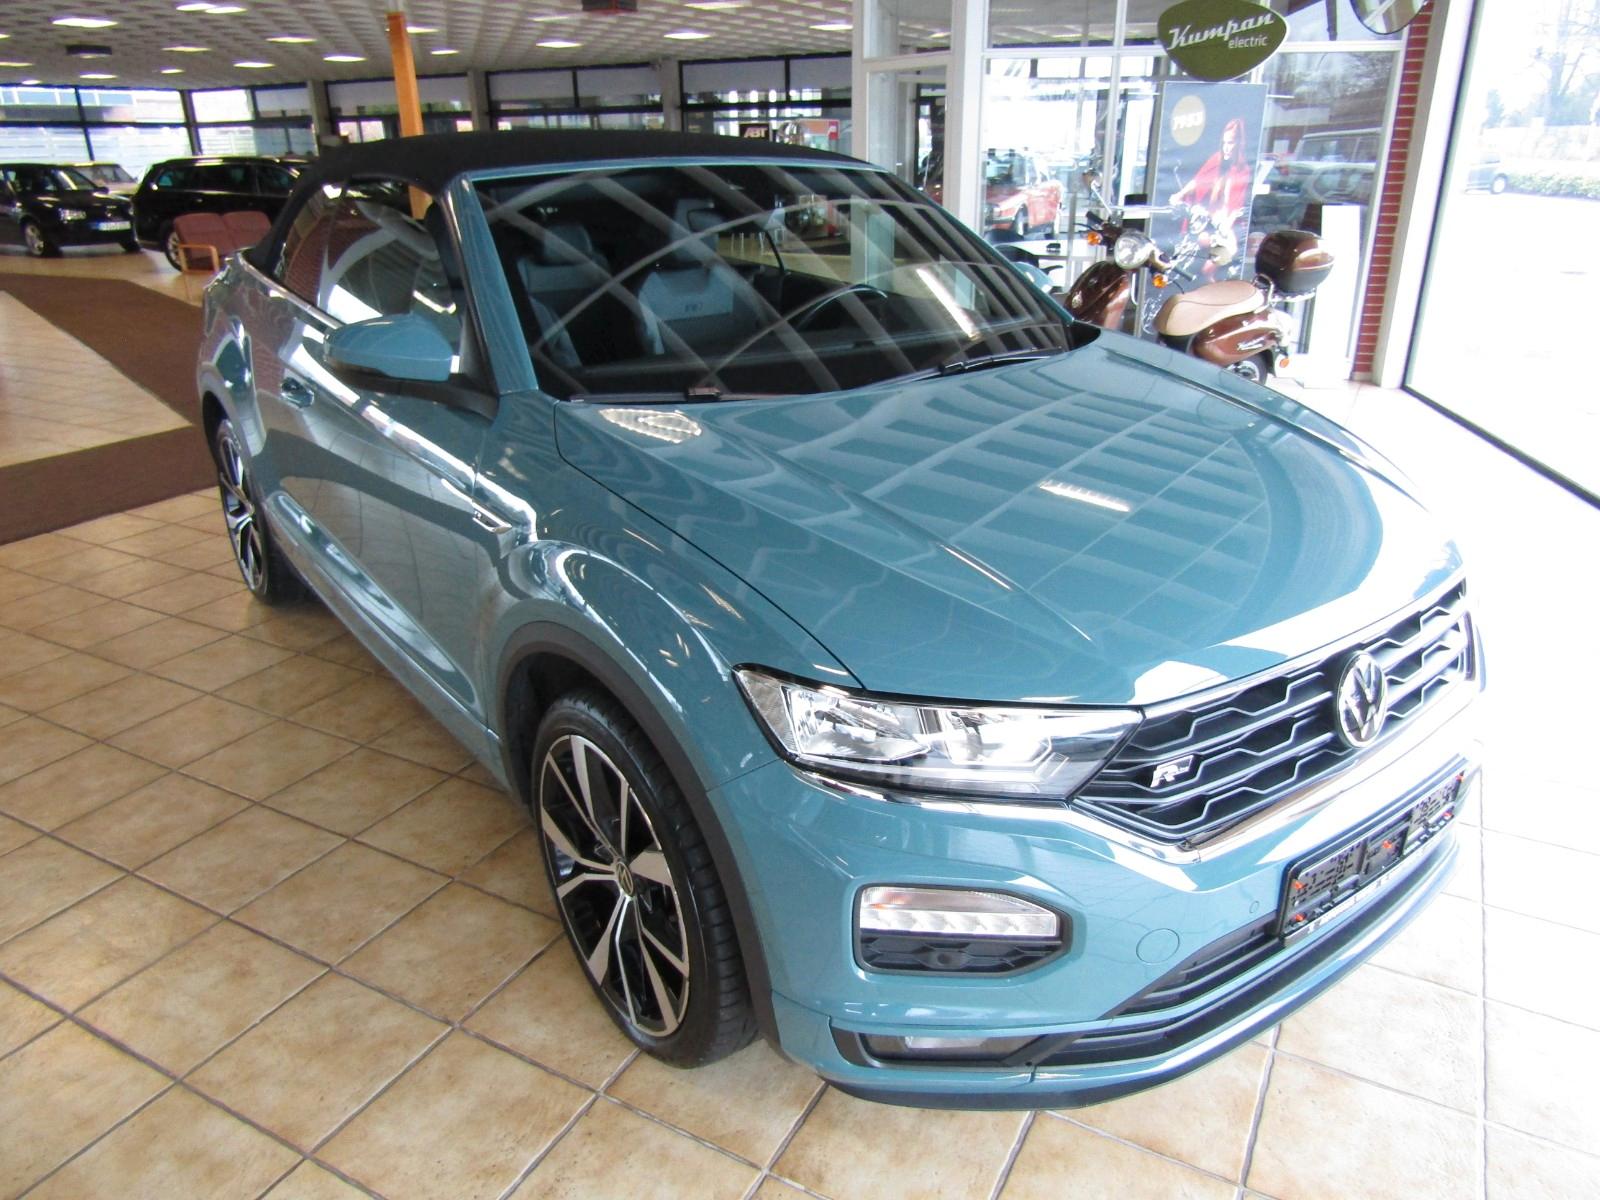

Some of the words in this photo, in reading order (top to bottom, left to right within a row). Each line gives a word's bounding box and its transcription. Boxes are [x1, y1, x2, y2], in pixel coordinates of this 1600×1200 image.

[1167, 13, 1274, 50] Kumpan
[1228, 35, 1268, 49] electric
[743, 126, 768, 138] ABT
